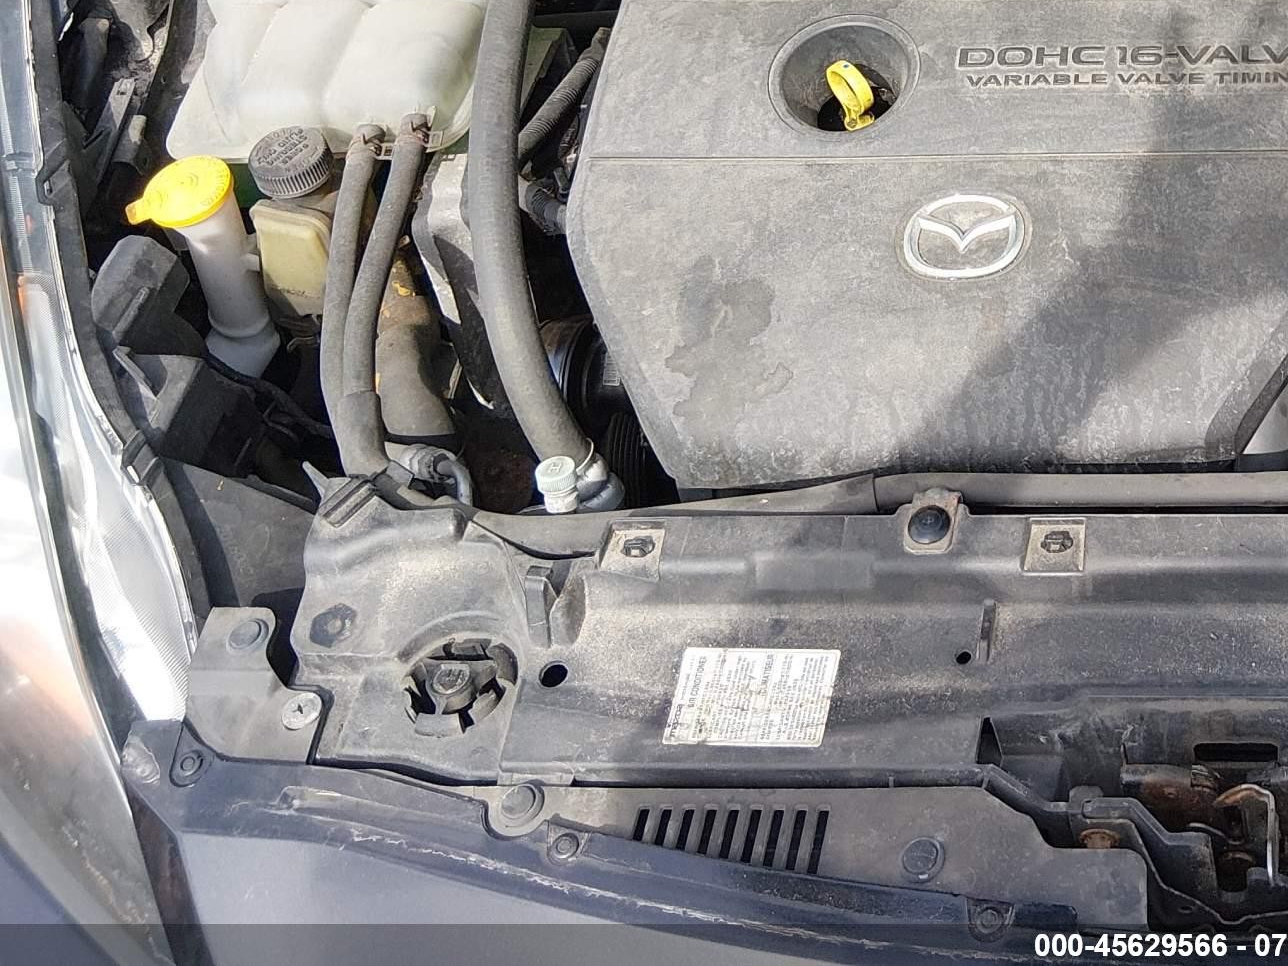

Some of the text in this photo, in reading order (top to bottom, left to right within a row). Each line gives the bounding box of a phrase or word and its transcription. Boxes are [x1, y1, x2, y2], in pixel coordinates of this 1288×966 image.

[957, 45, 1106, 69] DOHC
[966, 72, 1108, 88] VARIABLE
[1116, 71, 1205, 87] VALVE
[690, 656, 707, 696] CONDITIONER
[669, 703, 683, 738] mazda
